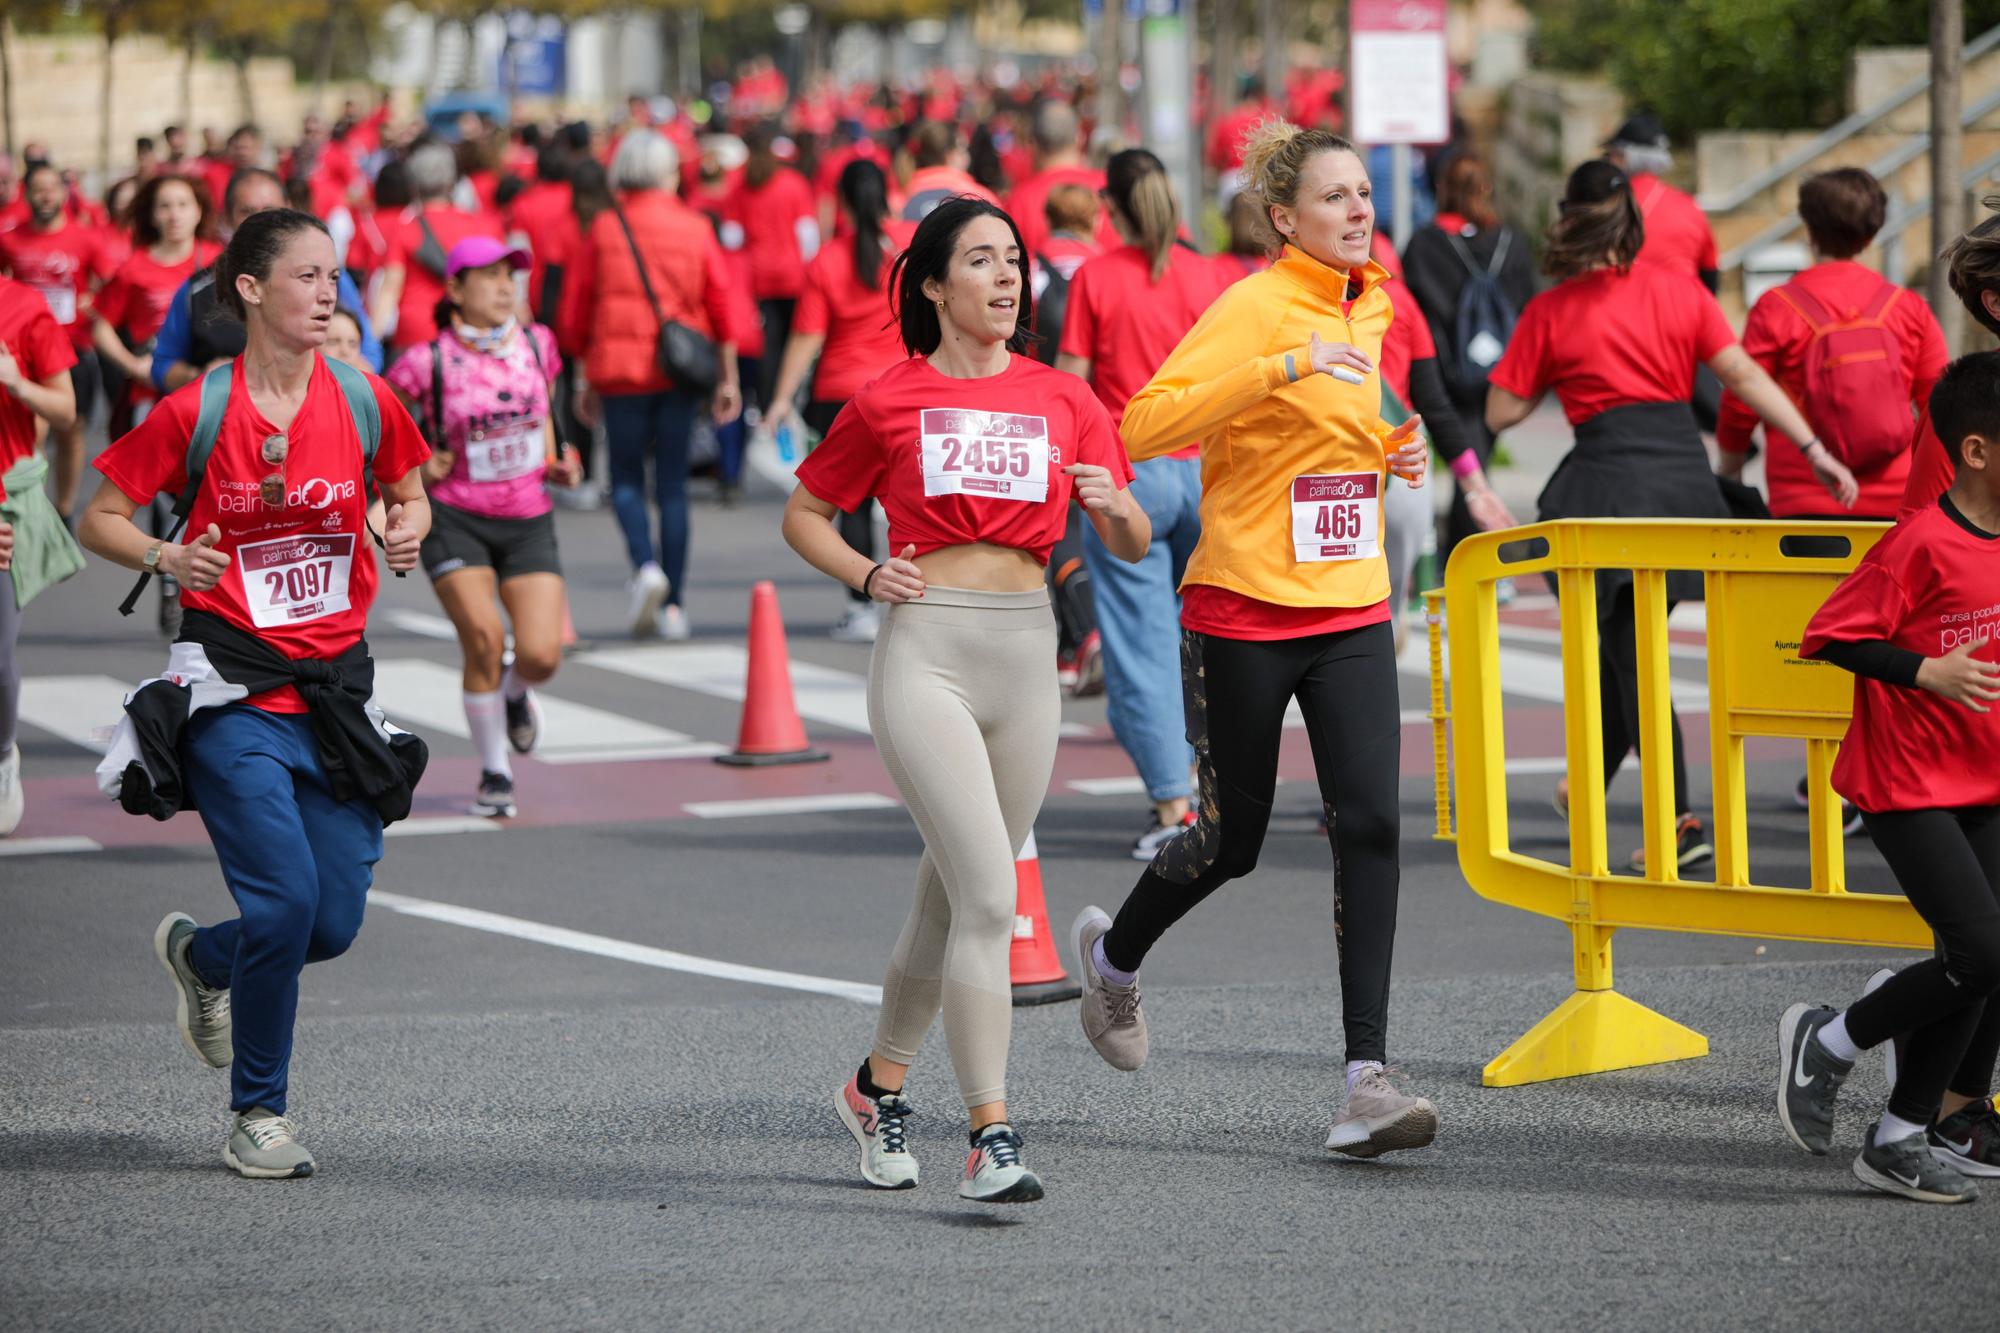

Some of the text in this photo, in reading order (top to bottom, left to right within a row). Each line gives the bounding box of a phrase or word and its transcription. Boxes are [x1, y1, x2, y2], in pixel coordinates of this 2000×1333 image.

[941, 438, 1030, 478] 2455
[1315, 503, 1361, 540] 465
[264, 560, 333, 605] 2097
[1940, 603, 2000, 623] cursa popula
